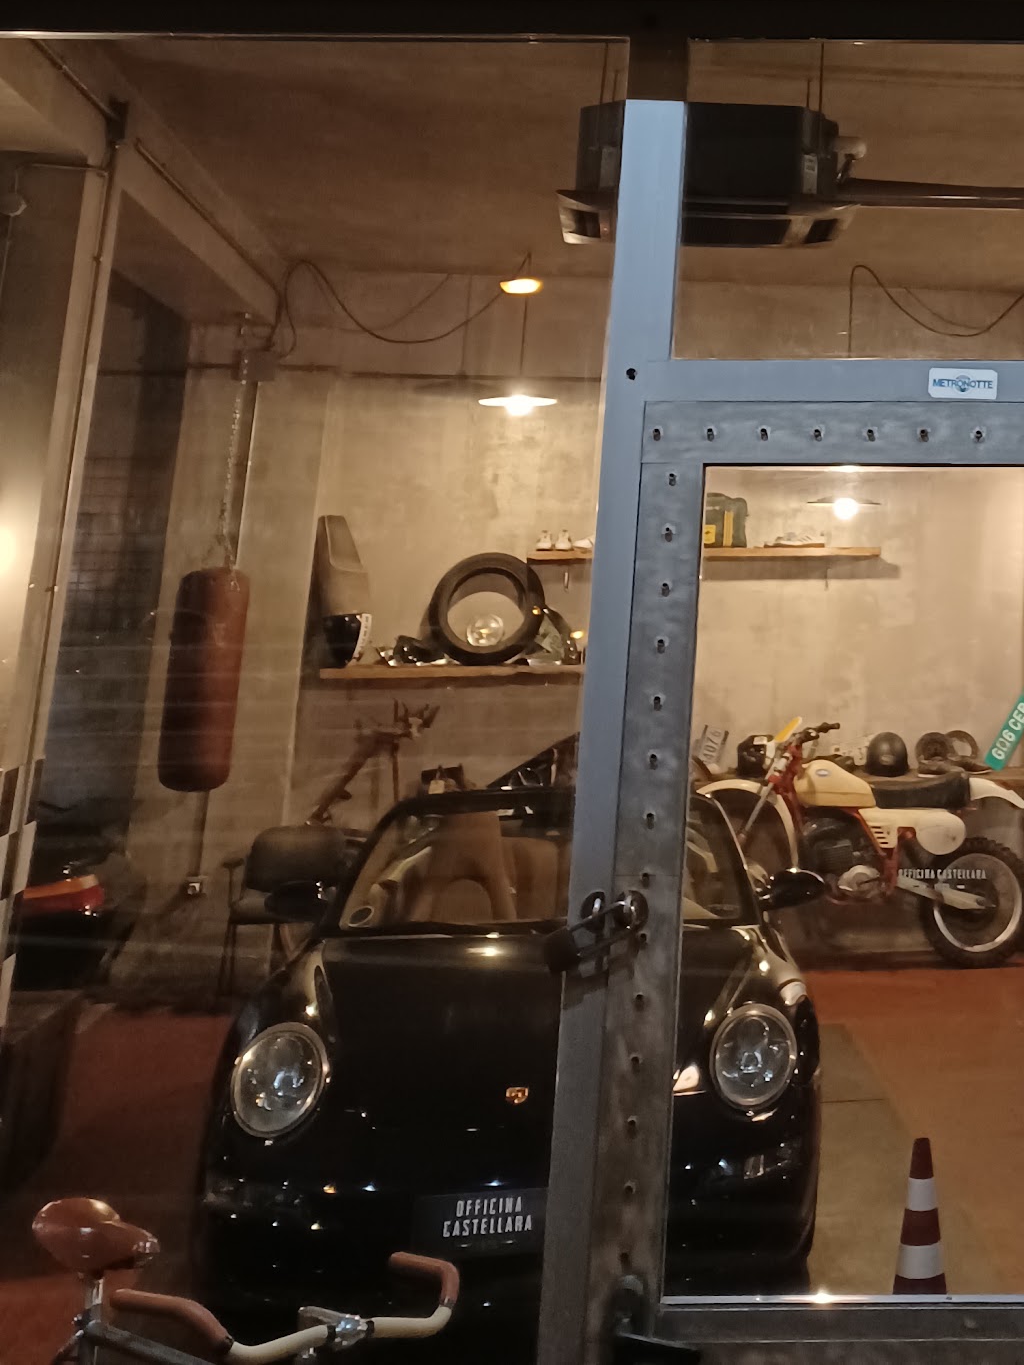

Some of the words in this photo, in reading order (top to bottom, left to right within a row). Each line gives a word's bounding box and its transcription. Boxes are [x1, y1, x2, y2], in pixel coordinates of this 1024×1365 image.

[932, 378, 993, 389] METRONOTTE
[456, 1196, 522, 1218] OFFICINA
[442, 1214, 533, 1238] CASTELLARA
